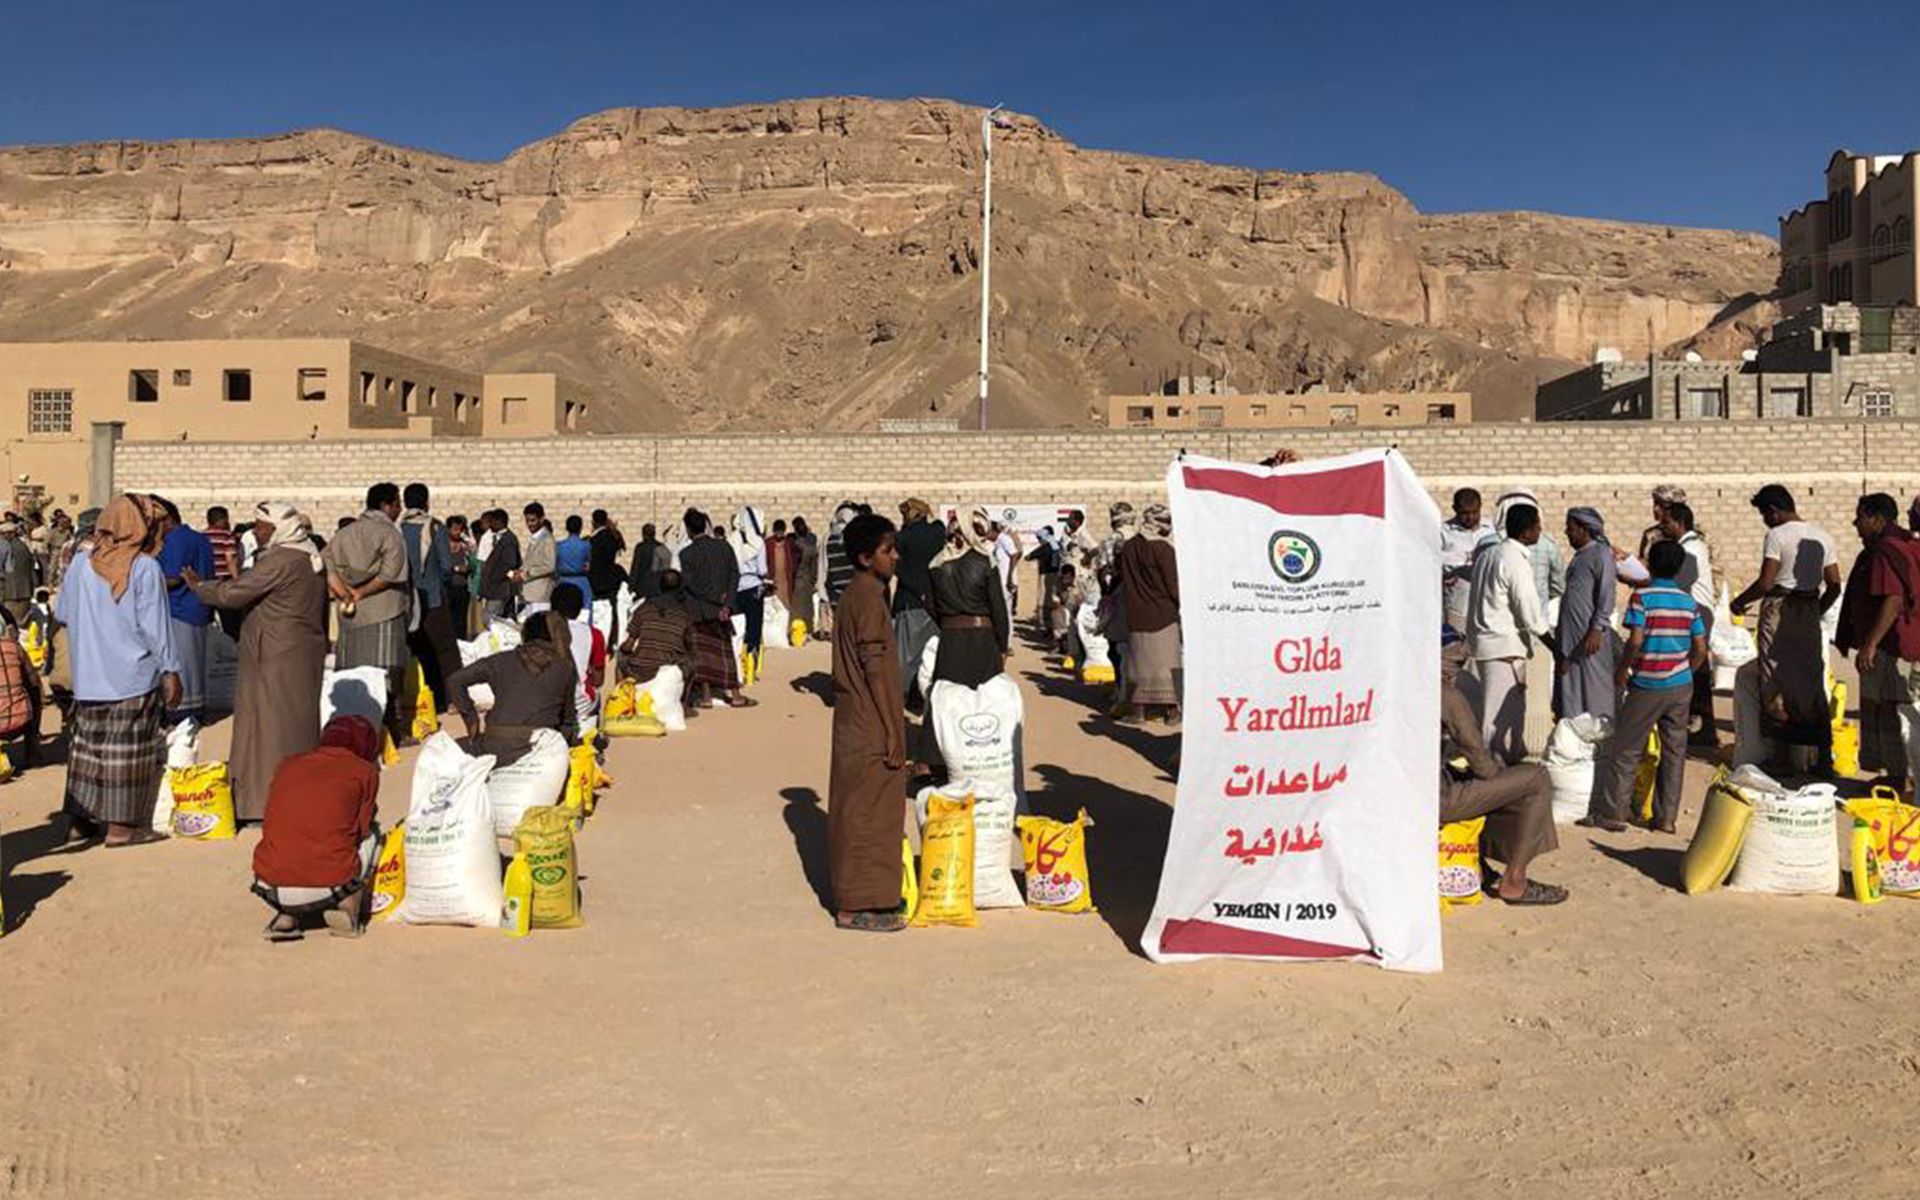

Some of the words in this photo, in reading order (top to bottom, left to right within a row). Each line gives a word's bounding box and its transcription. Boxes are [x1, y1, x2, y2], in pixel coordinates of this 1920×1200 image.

[1213, 902, 1280, 919] YEMEN
[1285, 903, 1292, 921] /
[1296, 903, 1337, 920] 2019
